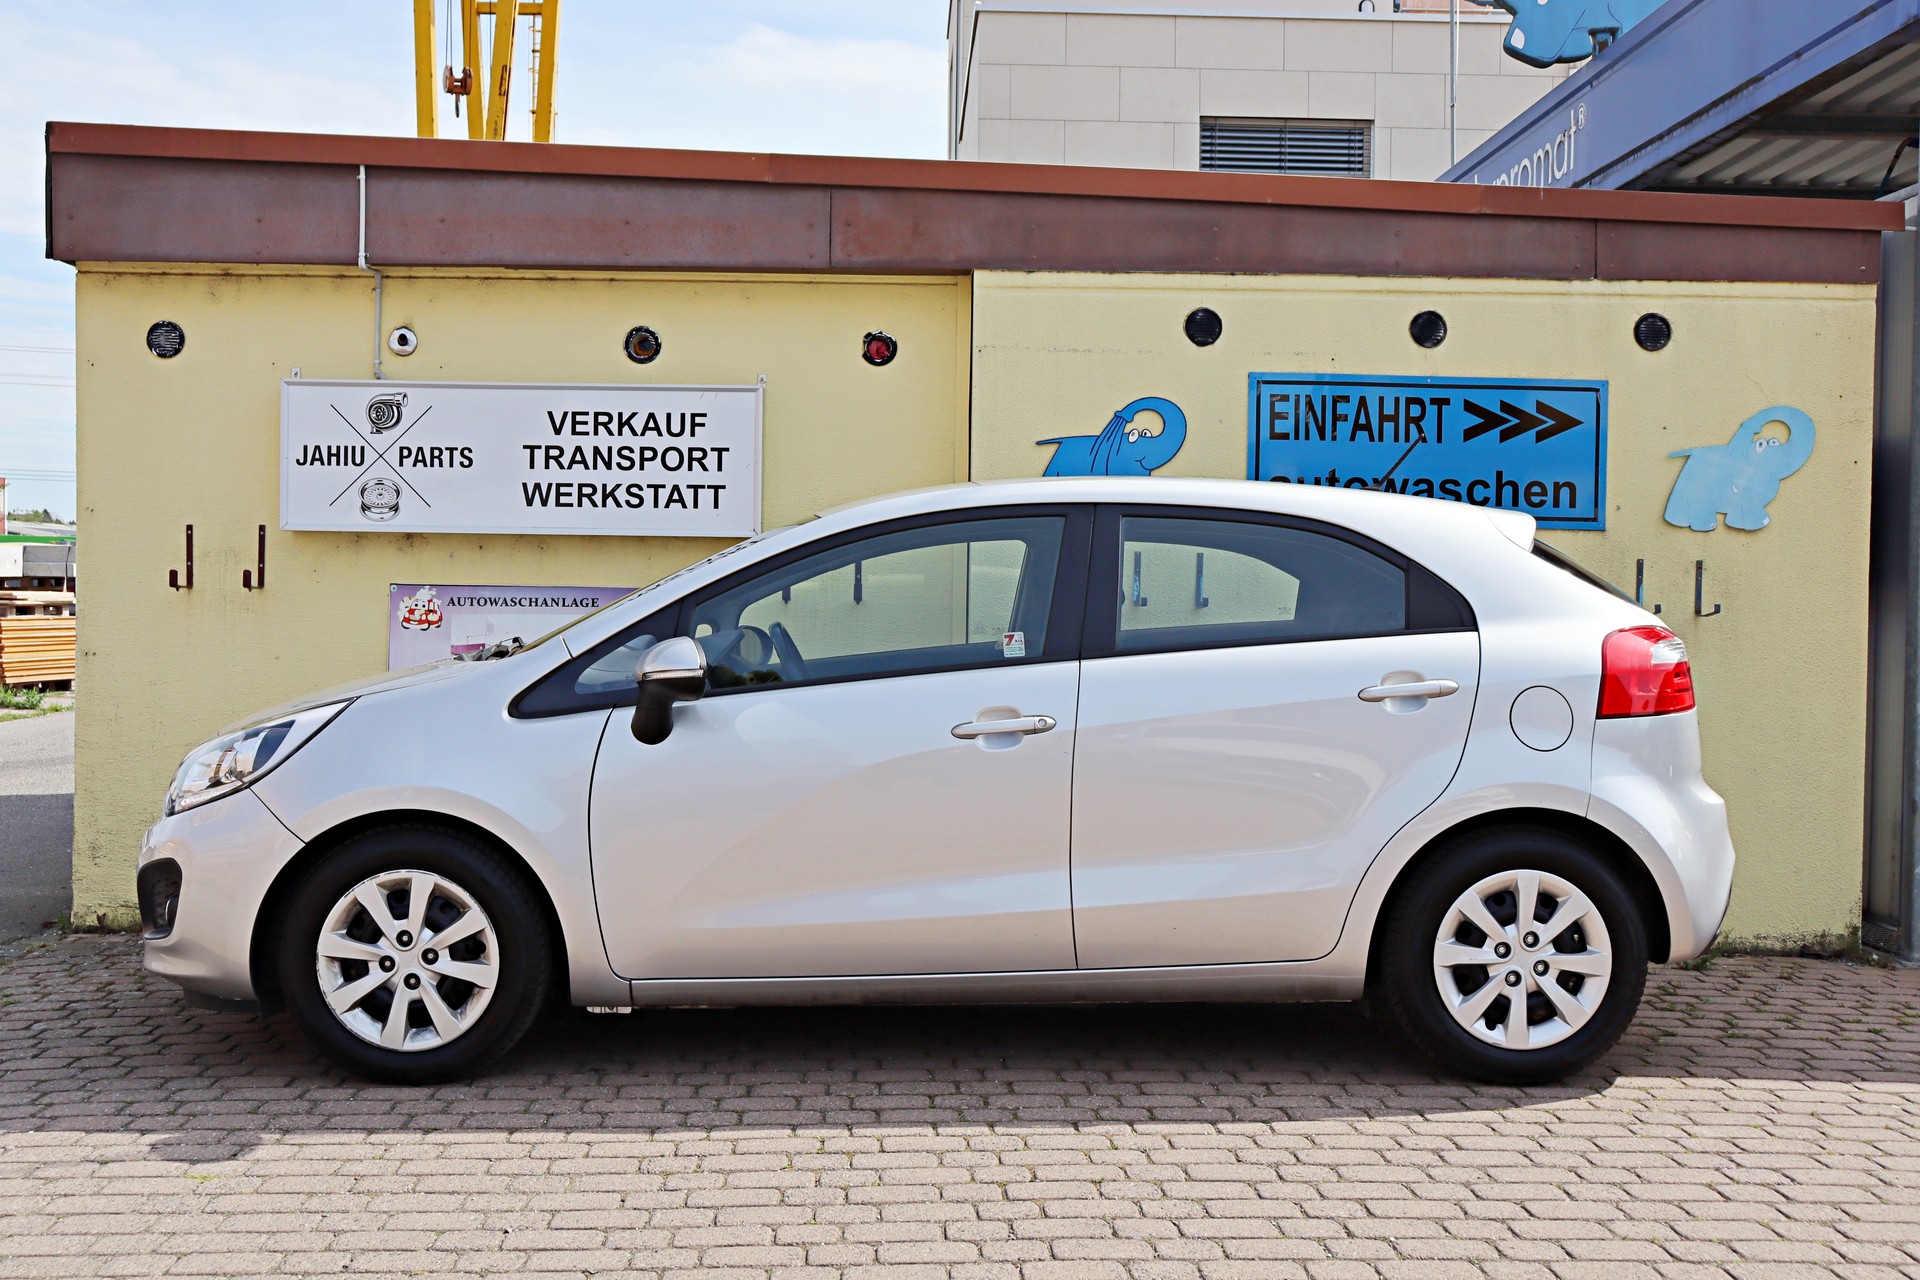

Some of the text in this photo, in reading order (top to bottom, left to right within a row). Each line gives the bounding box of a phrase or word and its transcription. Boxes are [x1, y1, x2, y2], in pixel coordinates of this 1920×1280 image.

[546, 410, 708, 438] VERKAUF
[1268, 393, 1451, 444] EINFAHRT
[295, 444, 474, 469] JAHIU PARTS
[522, 444, 730, 472] TRANSPORT
[521, 482, 727, 510] WERKSTATT
[1268, 468, 1577, 510] aschen
[446, 596, 600, 608] AUTOWASCHANLAGE
[1004, 634, 1015, 647] 7
